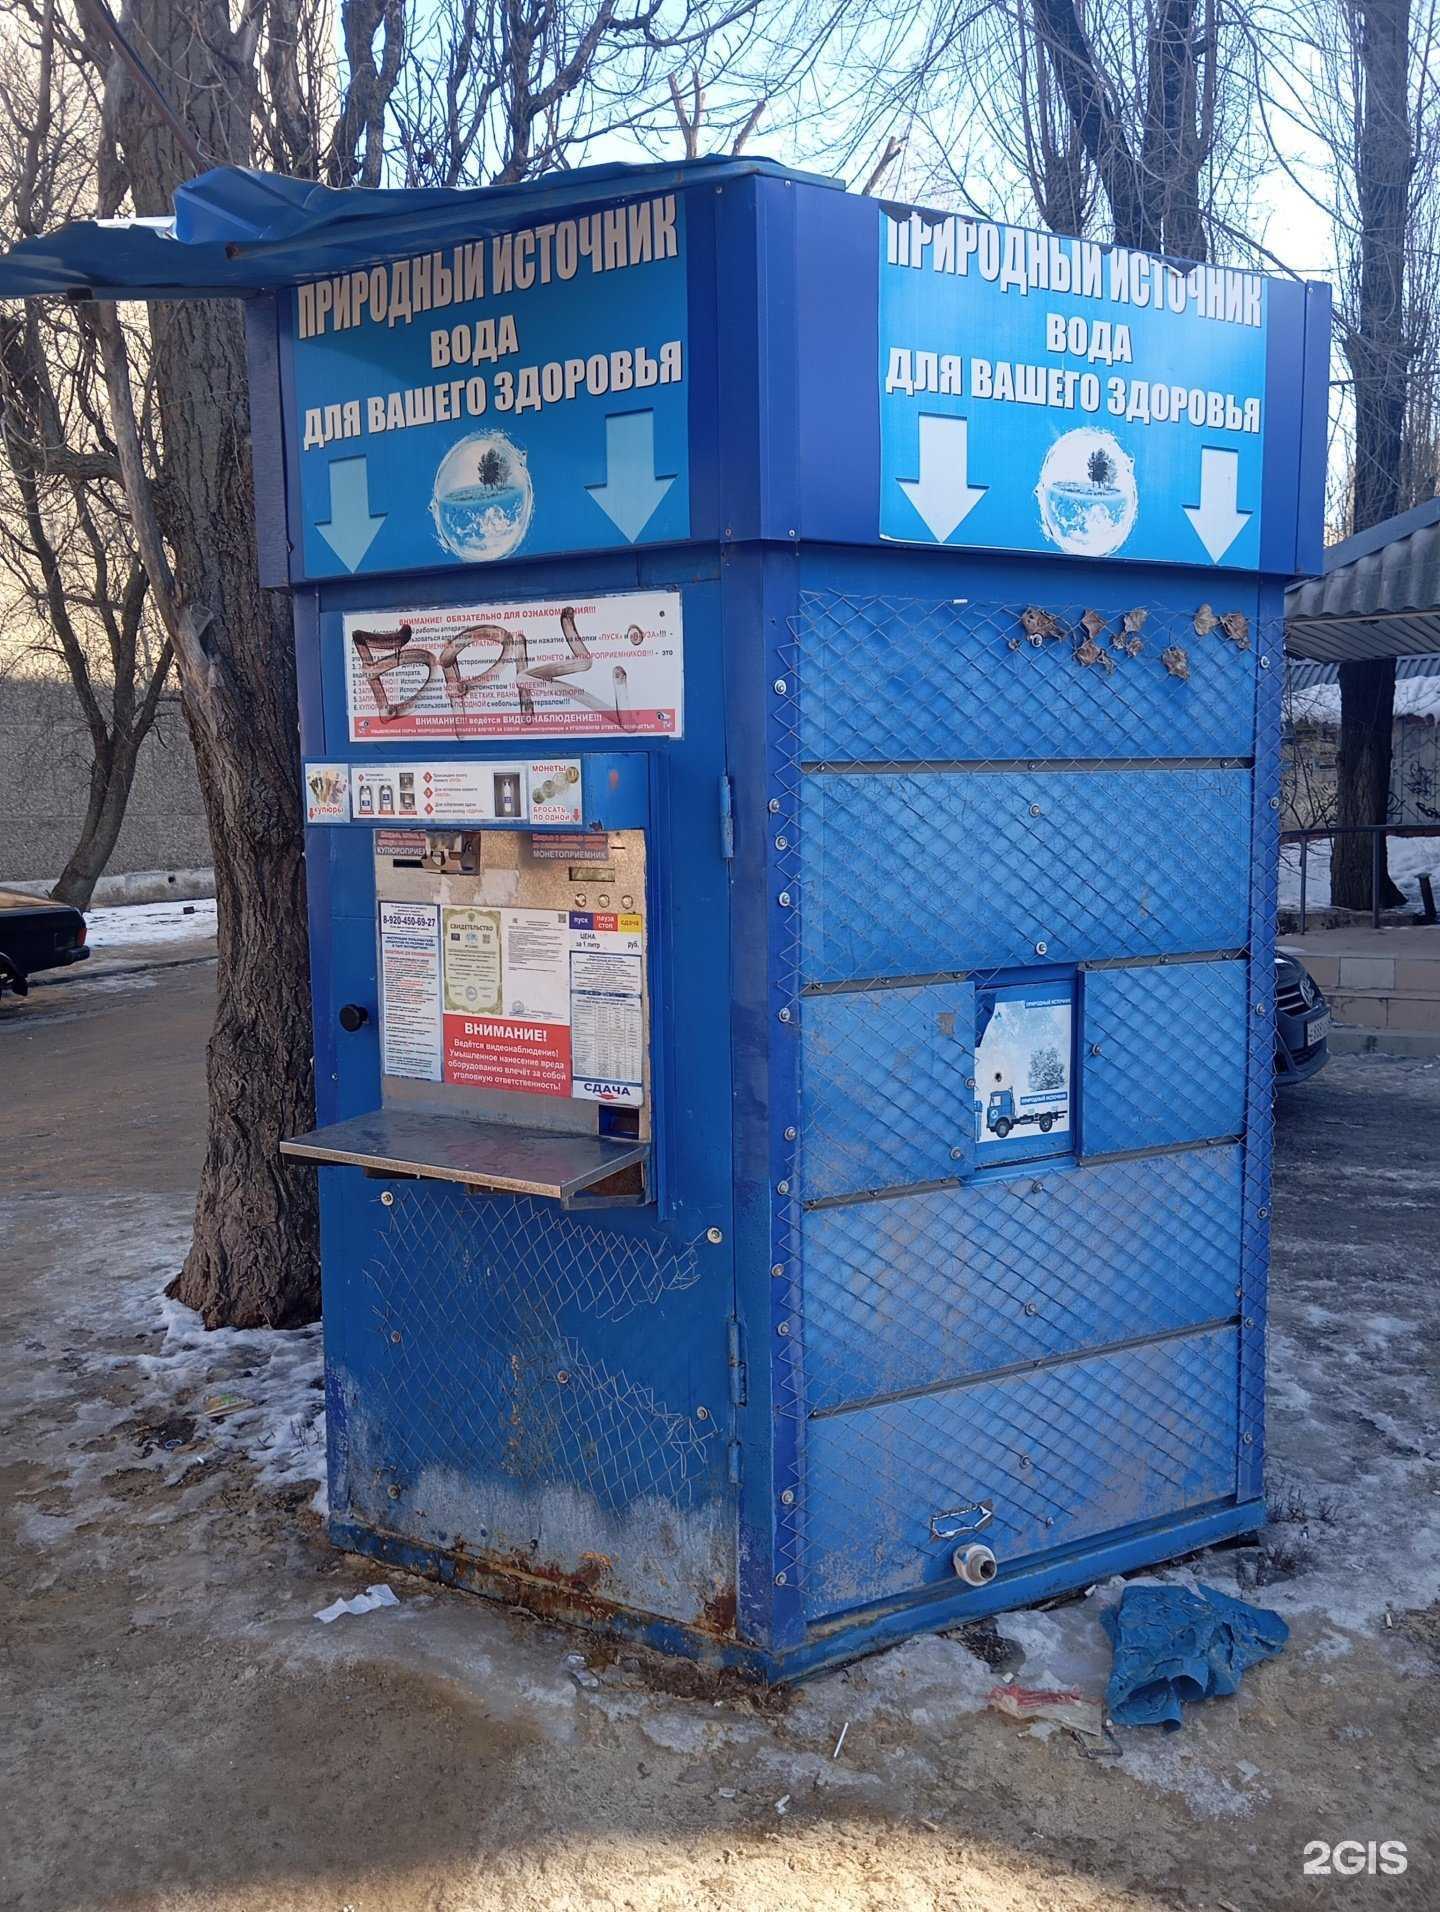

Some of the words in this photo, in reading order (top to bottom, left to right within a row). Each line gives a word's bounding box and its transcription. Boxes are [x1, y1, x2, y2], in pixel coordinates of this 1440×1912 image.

[493, 194, 678, 295] ИСТОЧНИК
[1110, 247, 1263, 328] ИСТОЧНИК
[430, 314, 519, 368] ВОДА
[1046, 312, 1134, 366] ВОДА
[303, 400, 361, 451] ДЛЯ
[367, 376, 487, 434] ВАШЕГО
[494, 340, 683, 414] ЗДОРОВЬЯ
[886, 347, 962, 396] ДЛЯ
[970, 357, 1100, 412] ВАШЕГО
[1107, 376, 1261, 434] ЗДОРОВЬЯ
[399, 616, 442, 625] ВНИМАНИЕ!
[446, 612, 501, 622] ОБЯЗАТЕЛЬНО
[503, 611, 519, 619] ДЛЯ
[522, 606, 595, 617] ОЗНАКОМНИЯ!!!
[415, 716, 465, 724] ВНИМАНИЕ!!!
[502, 713, 602, 724] ВИДЕОНАБЛЮДЕНИЕ!!!
[533, 849, 607, 859] МОНЕТОПРИЕМНИК
[464, 1022, 548, 1042] ВНИМАНИЕ!
[449, 1048, 498, 1061] Умышленное
[540, 1061, 564, 1070] вреда
[447, 1060, 503, 1073] оборудованию
[542, 1070, 566, 1081] собой
[453, 1071, 493, 1083] уголовную
[494, 1077, 561, 1090] ответственность!
[584, 1082, 631, 1096] СДАЧА
